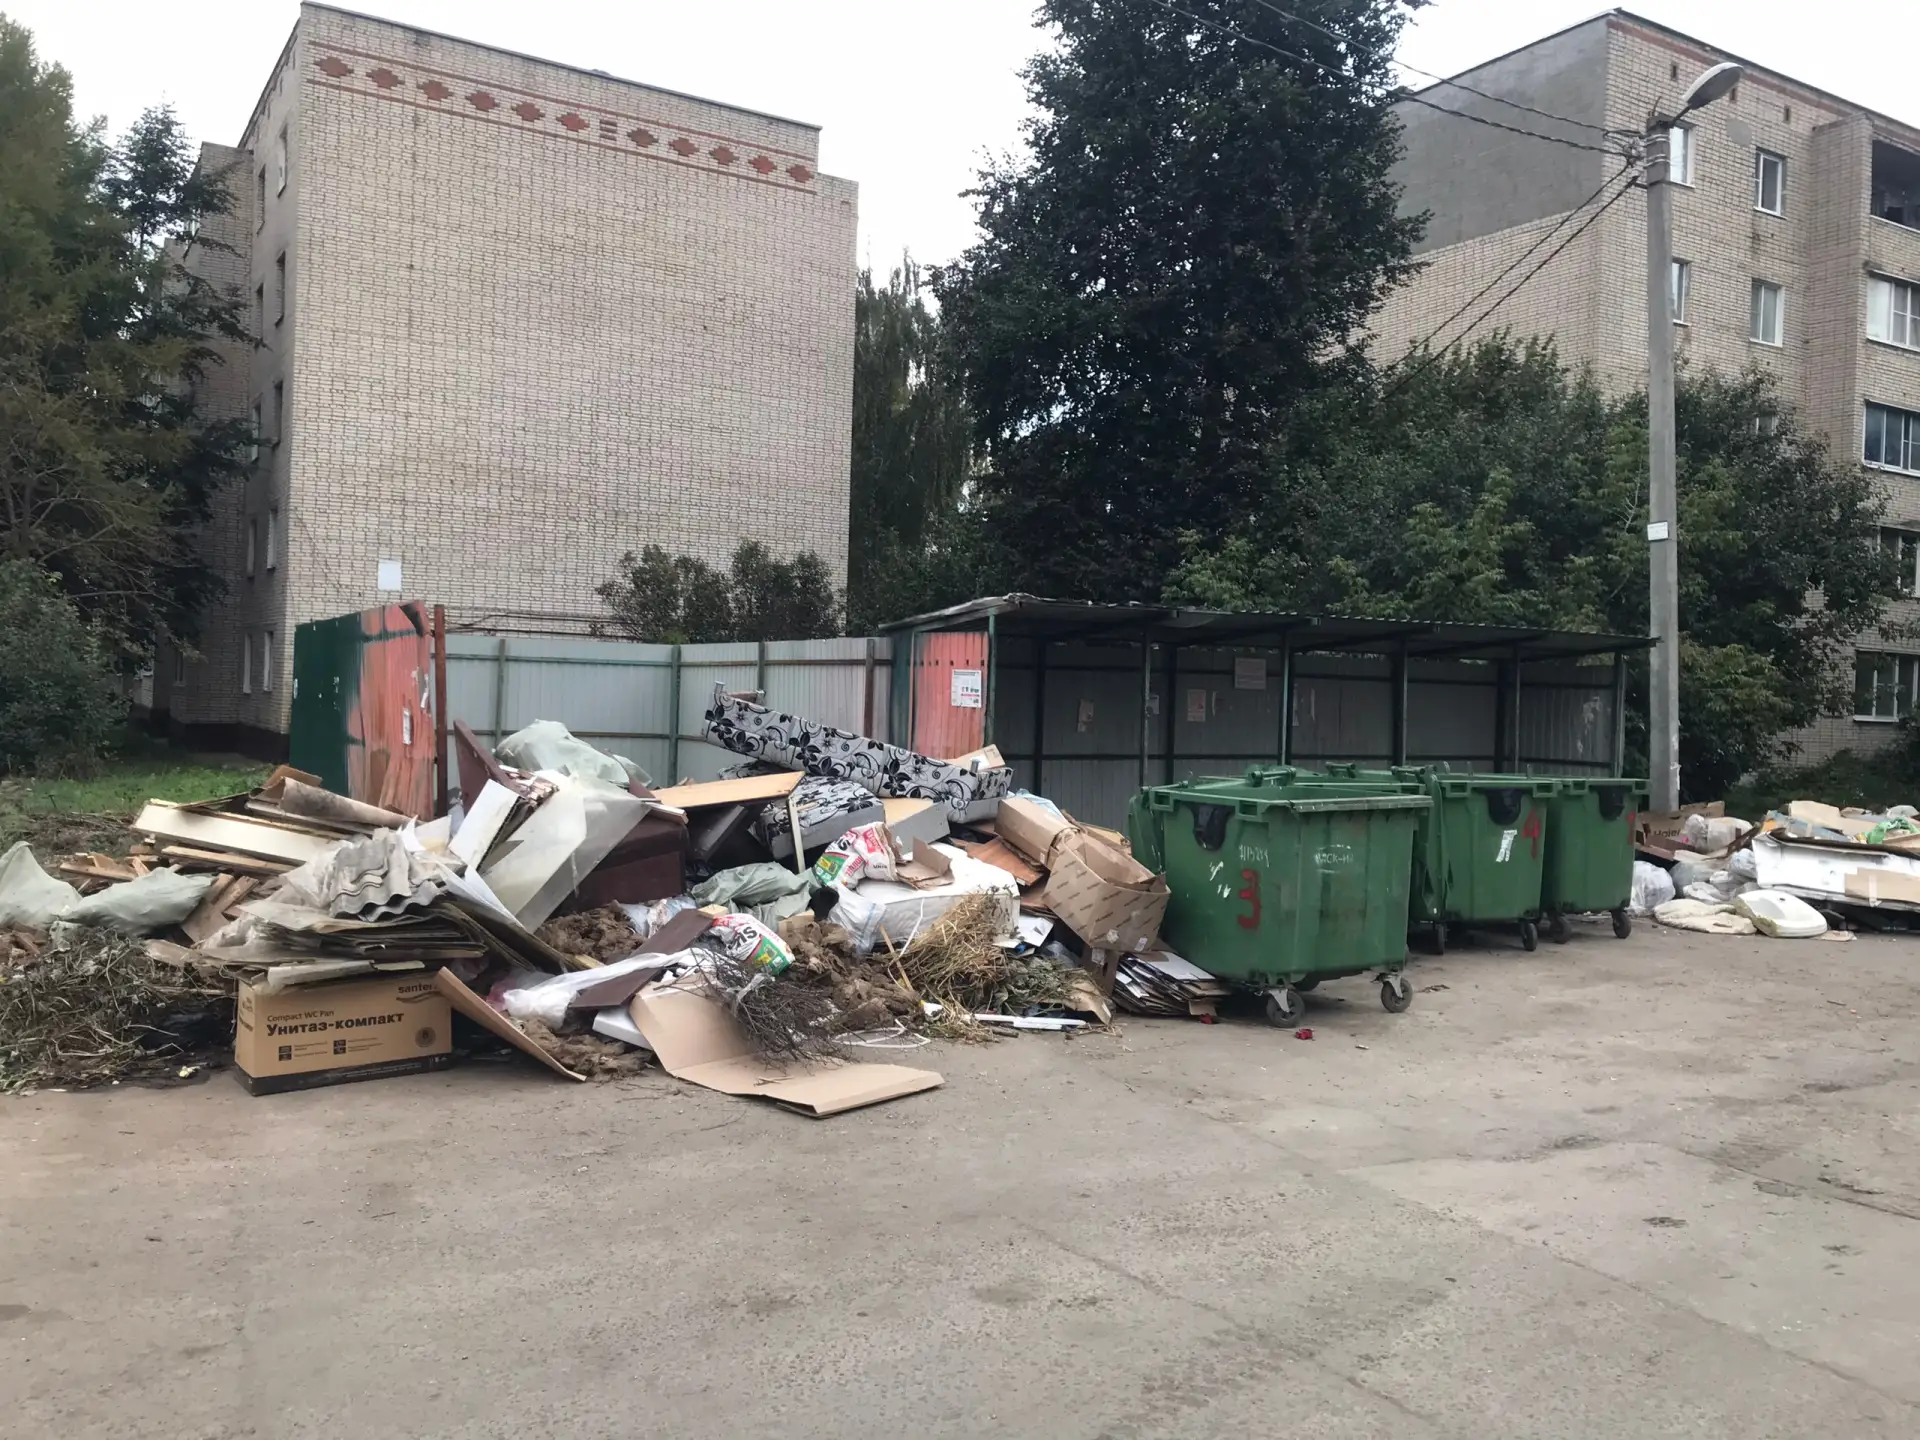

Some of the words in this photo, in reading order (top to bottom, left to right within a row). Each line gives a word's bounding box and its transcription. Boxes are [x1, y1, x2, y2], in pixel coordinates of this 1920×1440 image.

[1521, 807, 1541, 859] 4
[1236, 868, 1261, 930] 3
[266, 1012, 405, 1037] Унитаз-компакт
[267, 1013, 303, 1023] Compact
[304, 1010, 319, 1019] WC
[319, 1010, 335, 1018] Pan
